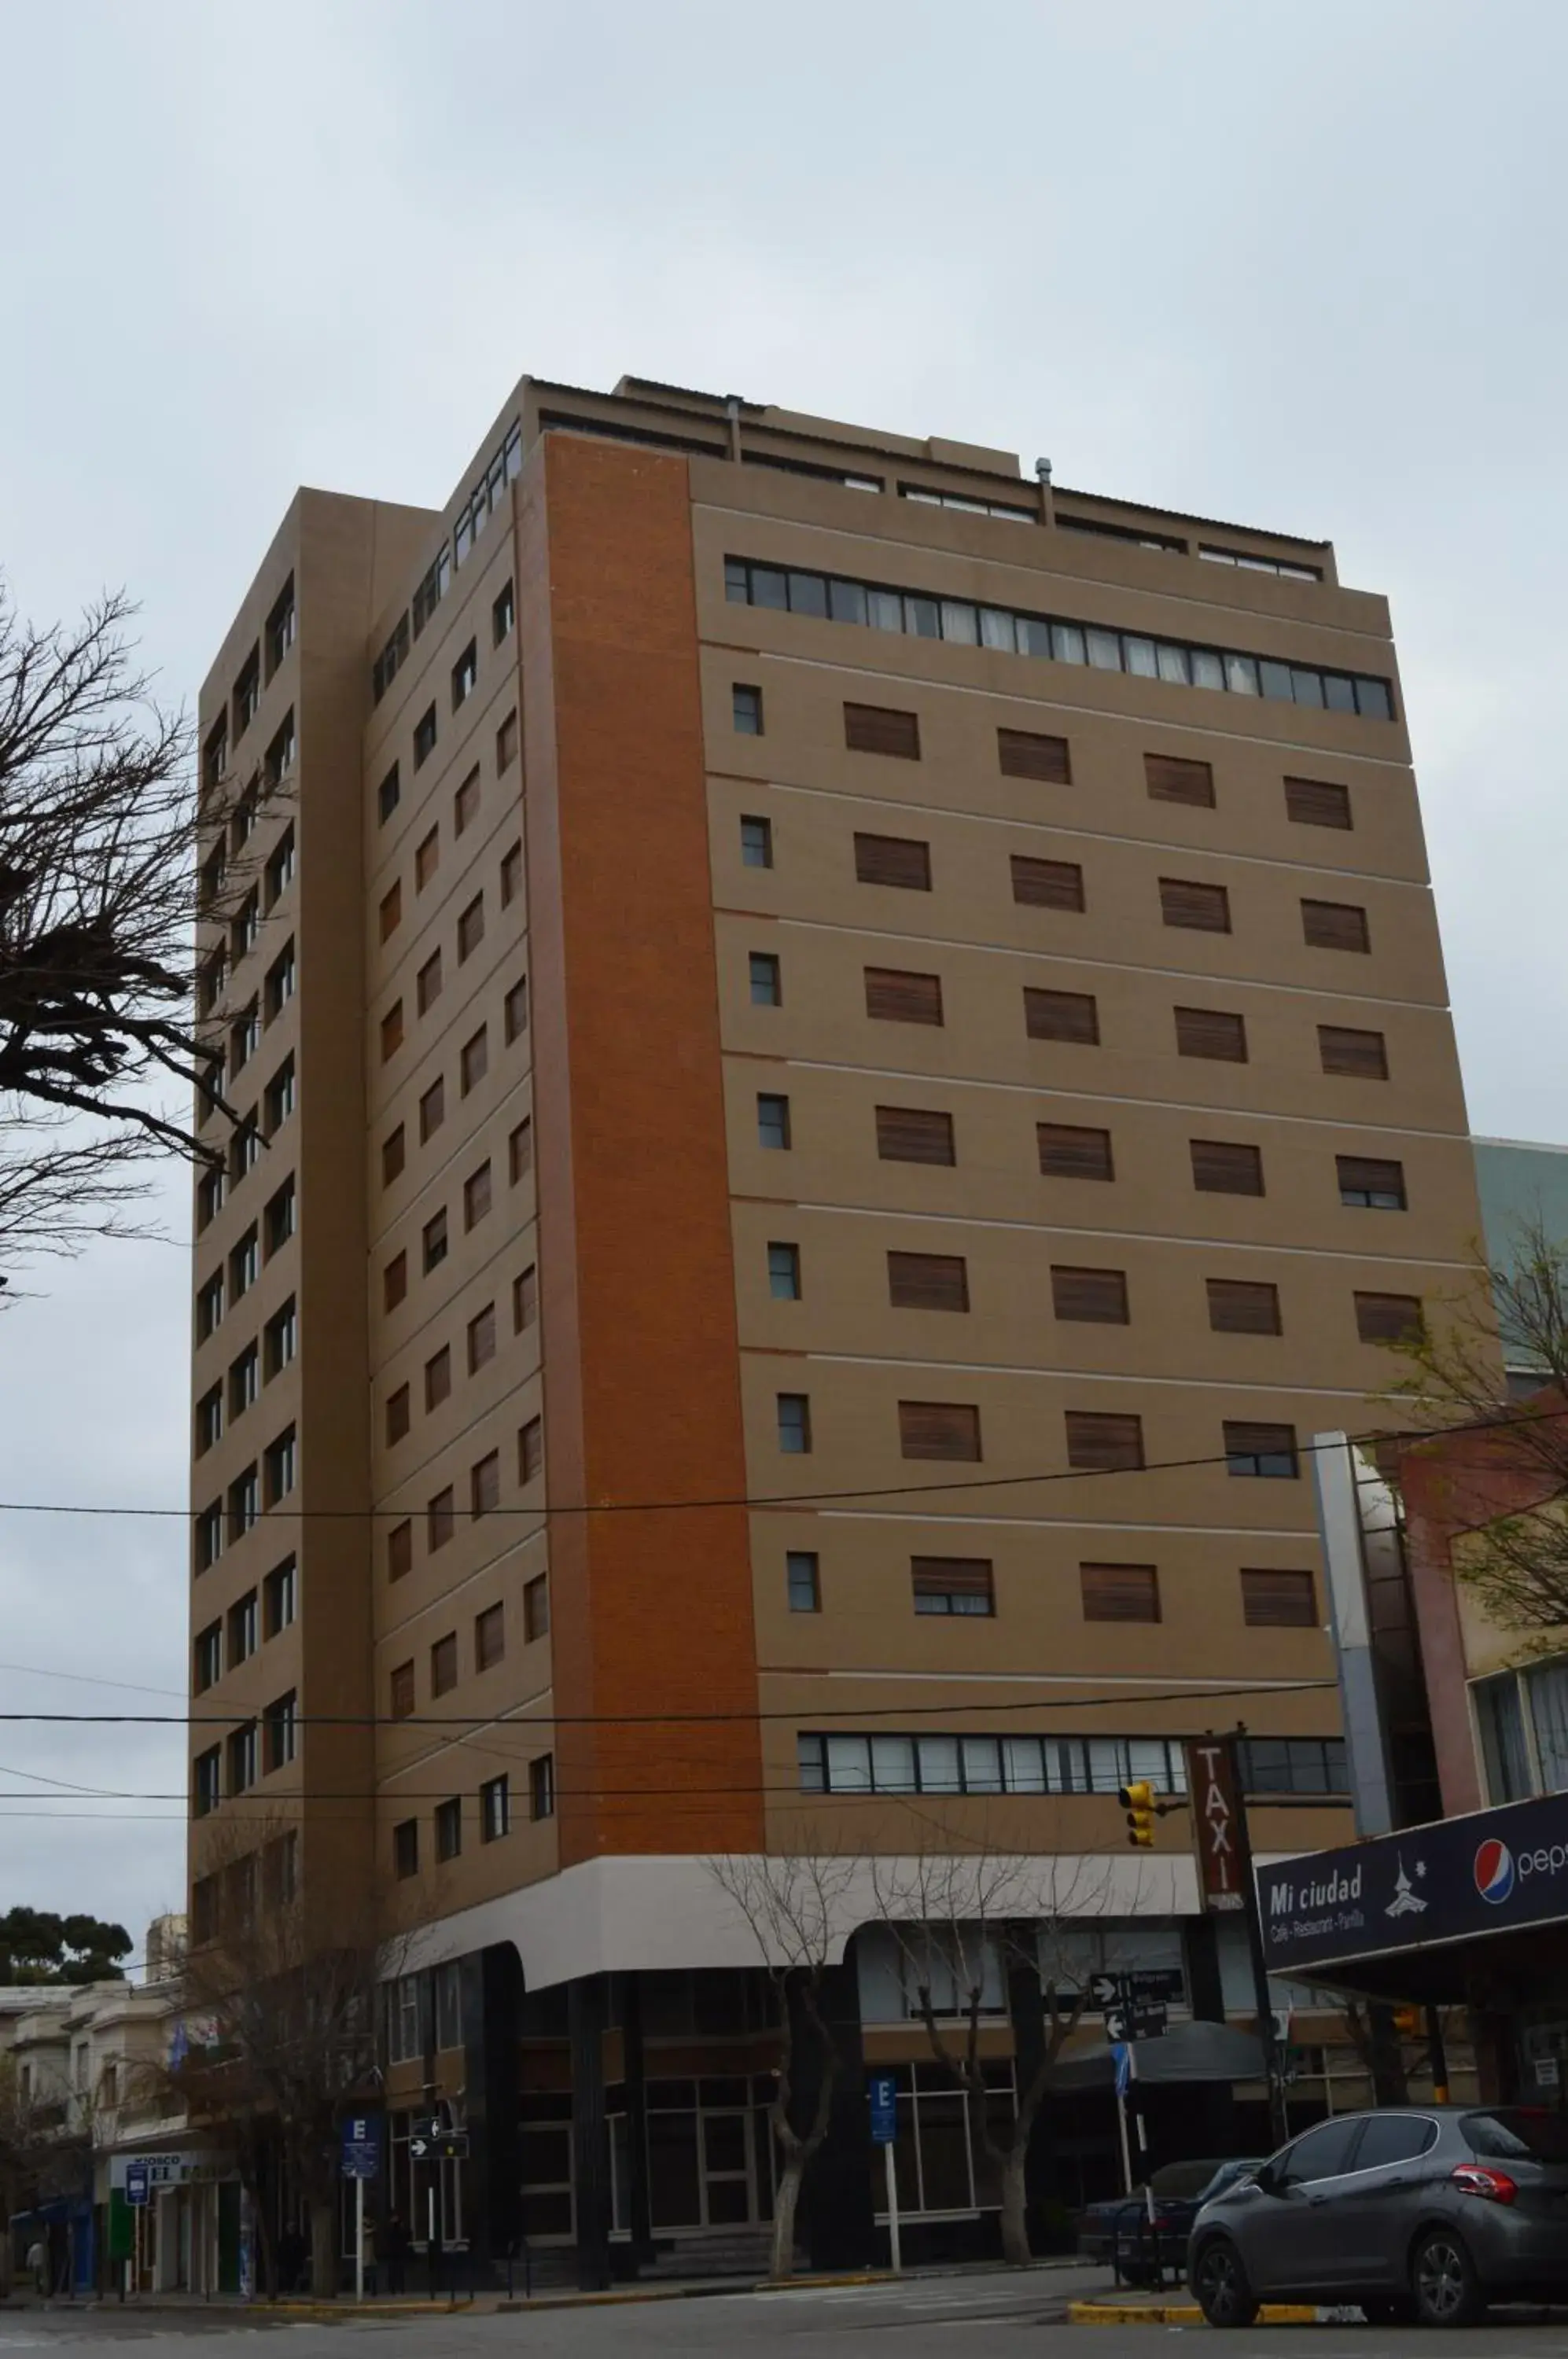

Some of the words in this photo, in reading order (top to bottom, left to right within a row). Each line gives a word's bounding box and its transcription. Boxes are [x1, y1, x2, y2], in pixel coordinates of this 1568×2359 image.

[1196, 1746, 1233, 1890] TAXI
[1270, 1882, 1294, 1916] Mi
[1300, 1863, 1361, 1909] ciudad
[878, 2081, 890, 2107] E
[352, 2119, 366, 2140] E
